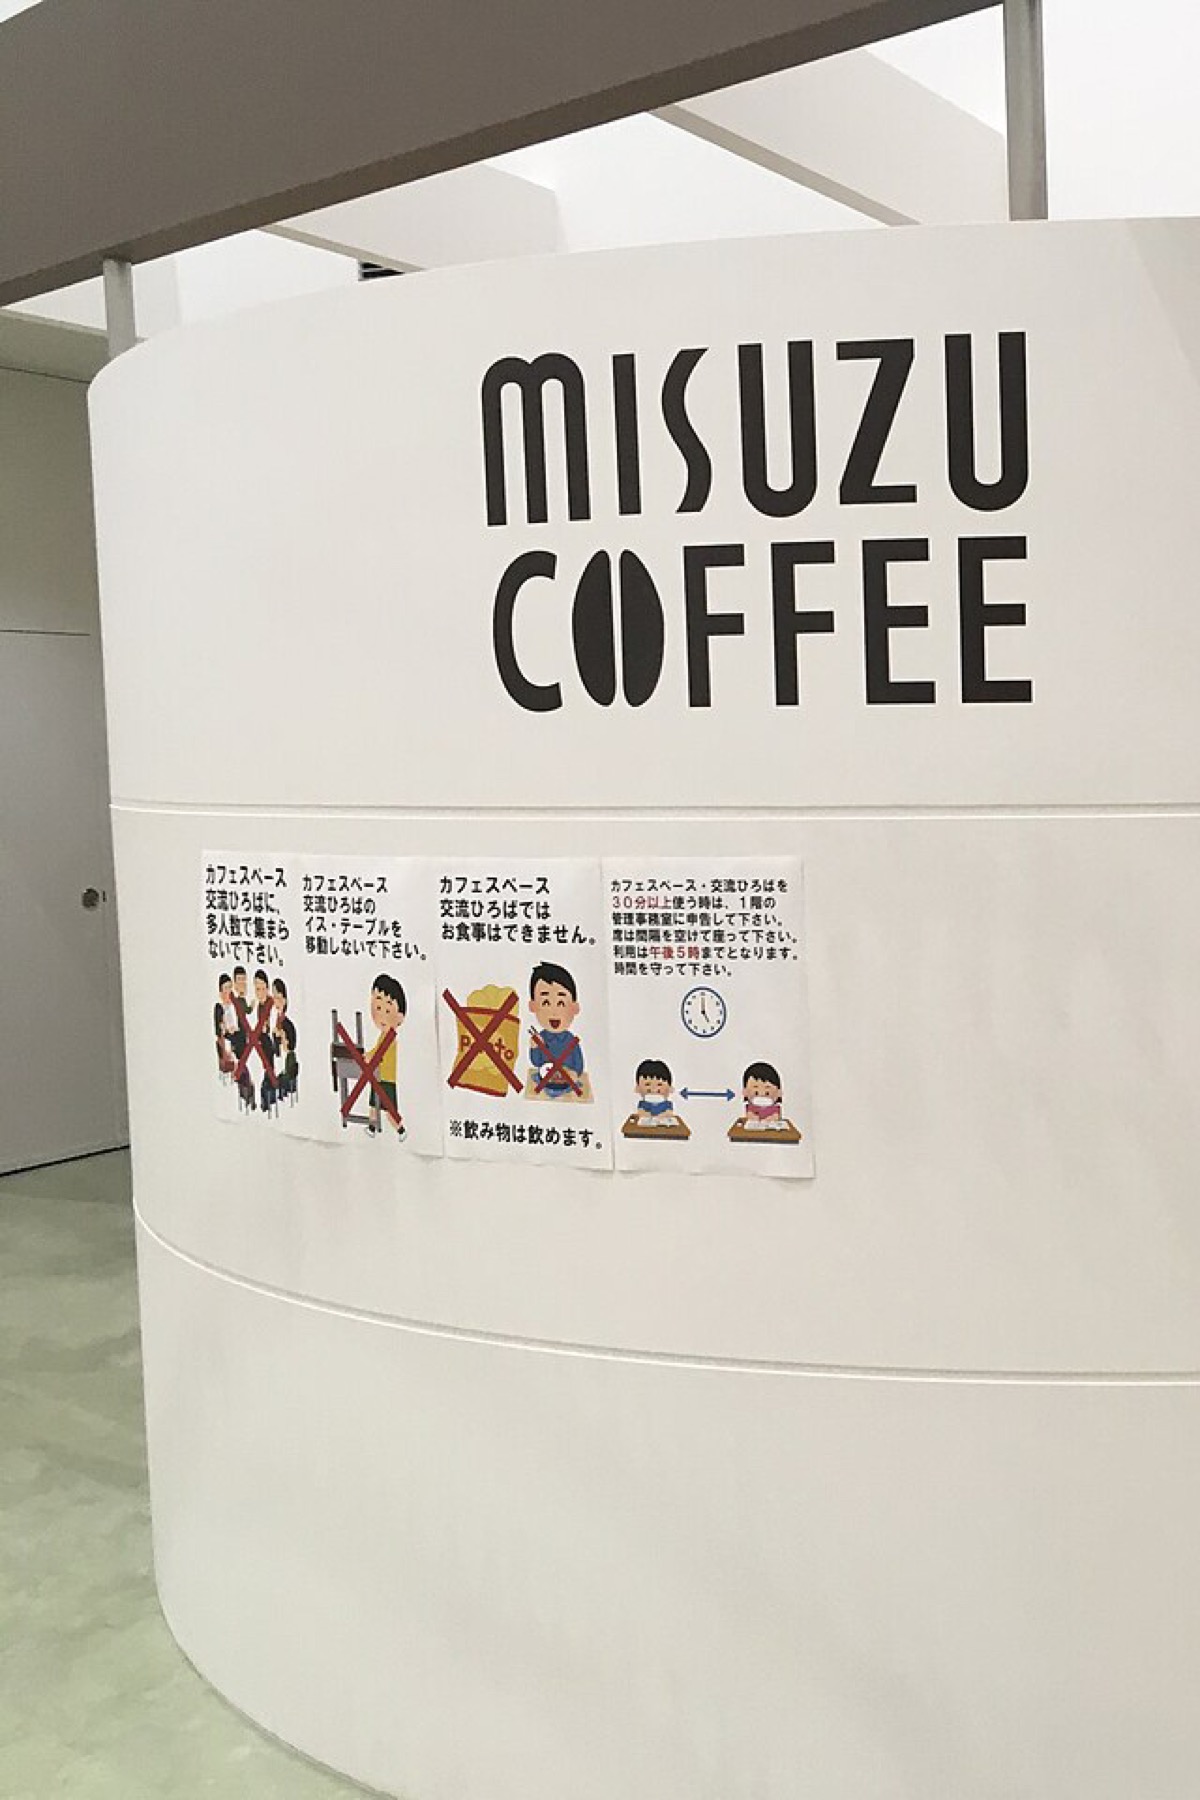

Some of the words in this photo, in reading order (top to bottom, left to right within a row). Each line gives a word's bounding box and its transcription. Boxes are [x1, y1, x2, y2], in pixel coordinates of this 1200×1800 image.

[481, 332, 1029, 526] MISUZU
[492, 536, 1032, 713] COFFEE
[206, 864, 287, 888] カフェスペース
[302, 874, 388, 893] カフェスペース
[440, 876, 550, 894] カフェスペース
[303, 894, 376, 915] 交流ひろばの
[440, 899, 551, 919] 交流ひろばでは
[206, 913, 290, 940] 多人数で集まら
[441, 922, 597, 945] お食事はできません。
[207, 939, 284, 966] ないで下さい。
[305, 935, 427, 960] 移動しないで下さい。
[614, 961, 732, 976] 時間を守って下さい。
